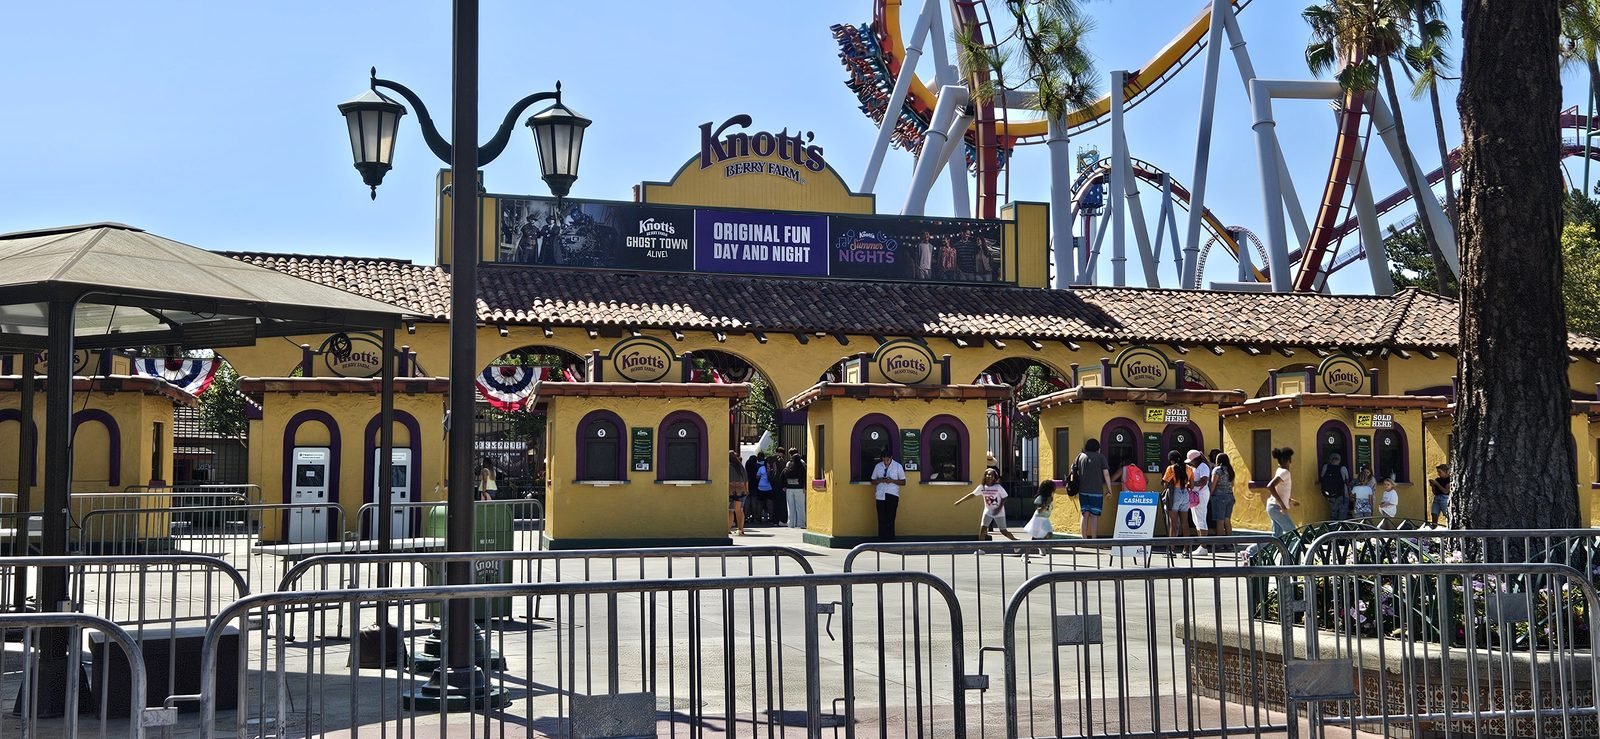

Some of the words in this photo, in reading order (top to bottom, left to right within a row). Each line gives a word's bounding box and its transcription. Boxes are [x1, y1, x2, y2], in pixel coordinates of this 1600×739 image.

[698, 113, 826, 172] Knott's
[726, 162, 765, 178] BERRY
[768, 162, 800, 182] FARM
[639, 217, 675, 234] Knott's
[713, 222, 780, 243] ORIGINAL
[784, 225, 811, 244] FUN
[626, 236, 657, 249] GHOST
[659, 238, 688, 250] TOWN
[646, 250, 668, 258] ALIVE!
[713, 242, 739, 260] DAY
[742, 244, 769, 261] AND
[772, 245, 811, 263] NIGHT
[839, 249, 895, 264] NIGHTS
[622, 351, 664, 370] Knott's
[887, 355, 926, 372] Knott's
[1127, 361, 1162, 378] Knott's
[1328, 369, 1359, 385] Knott's
[1165, 415, 1188, 423] HERE
[1166, 408, 1187, 416] SOLD
